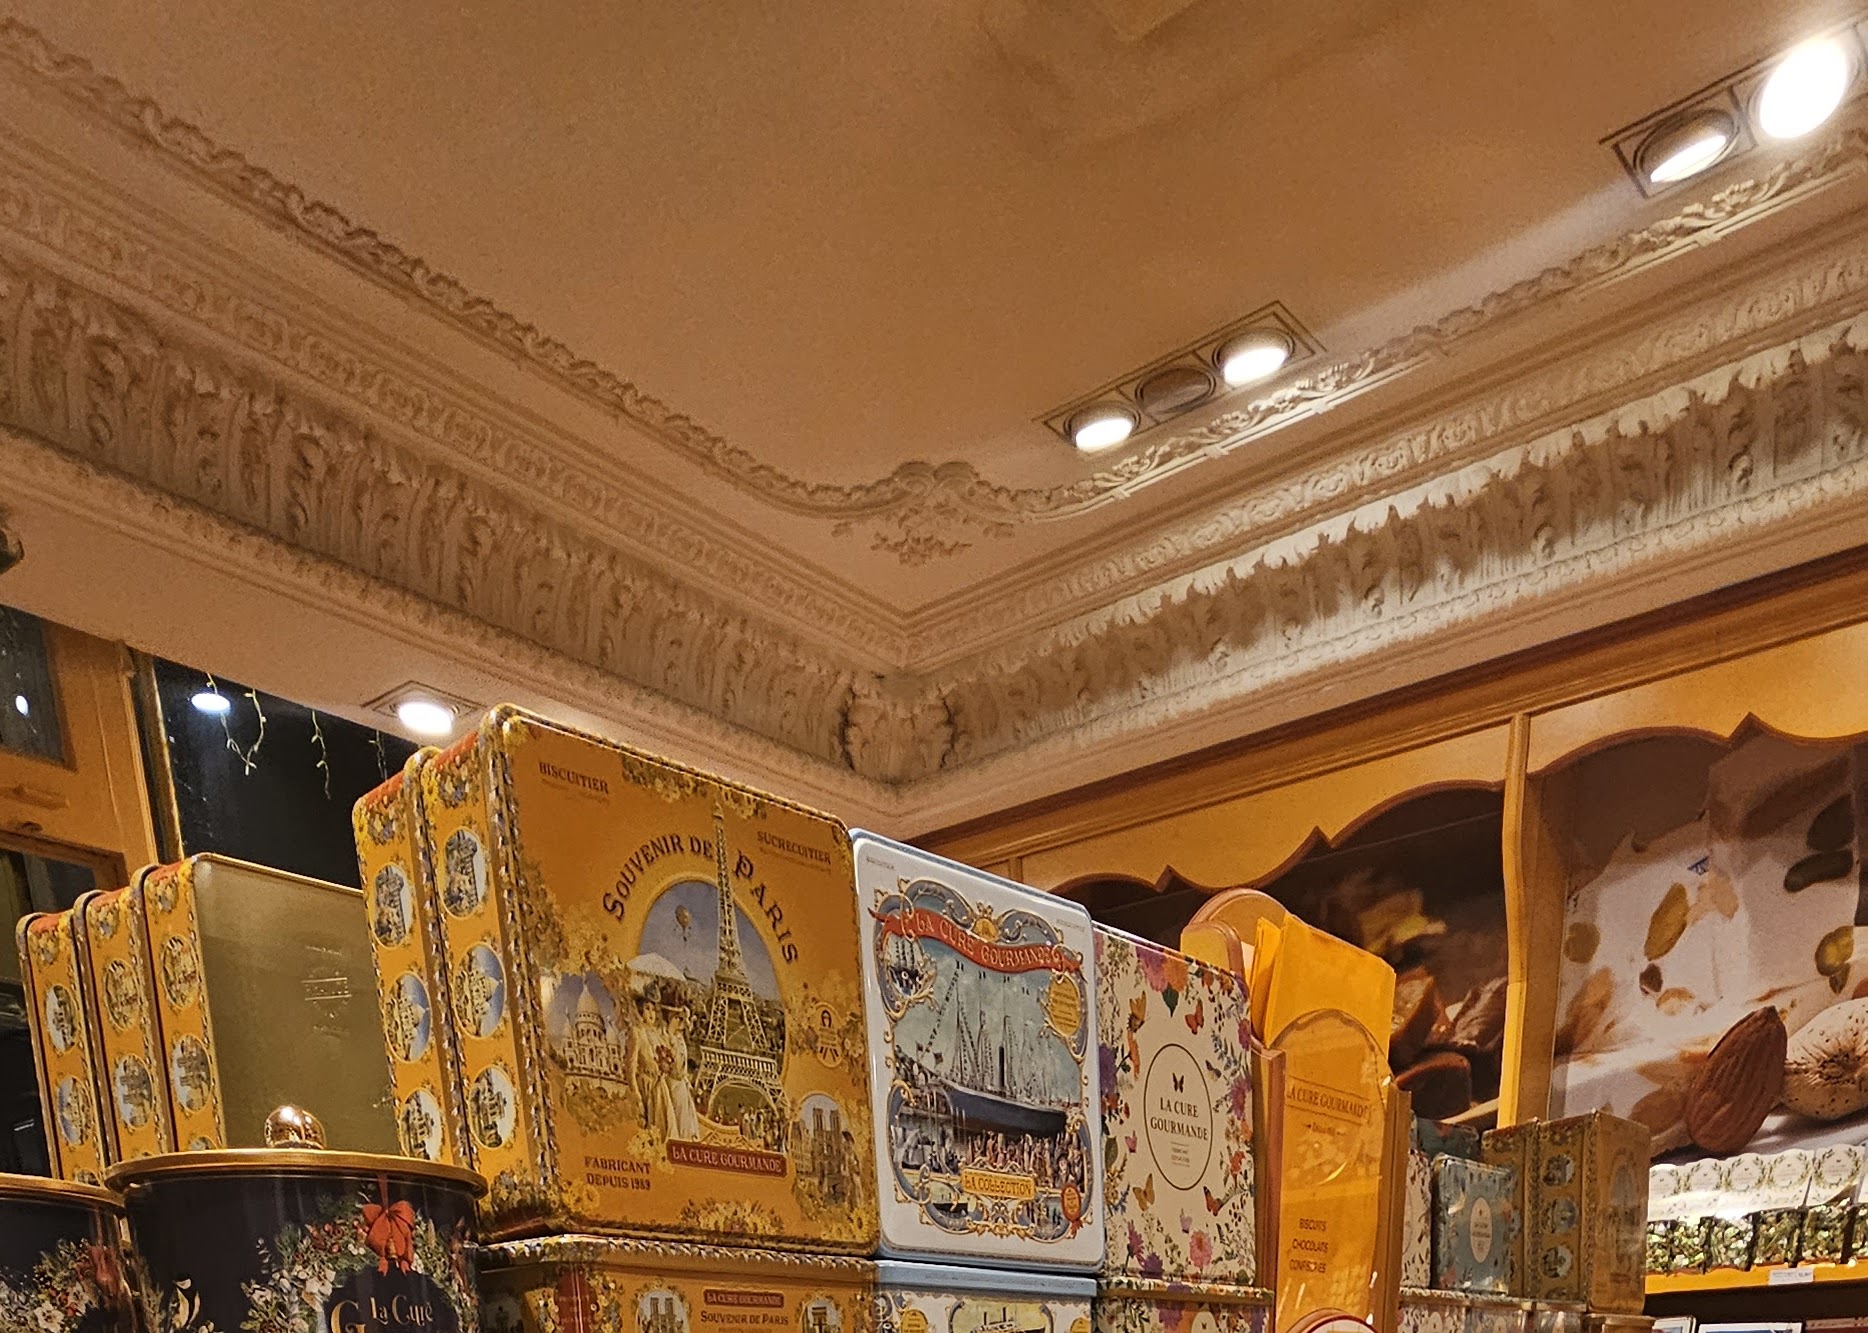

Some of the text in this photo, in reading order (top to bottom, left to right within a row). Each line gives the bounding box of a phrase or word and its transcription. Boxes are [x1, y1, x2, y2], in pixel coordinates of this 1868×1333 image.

[539, 761, 609, 794] BISCUITIER
[603, 832, 799, 965] SOUVENIR DE PARIS
[916, 914, 934, 934] LA
[938, 918, 974, 956] CURE
[1298, 1087, 1319, 1106] CURE
[1160, 1097, 1199, 1118] LA CURE
[1150, 1116, 1208, 1141] GOURMANDE
[584, 1156, 651, 1175] FABRICANT
[672, 1146, 783, 1173] LA CURE GOURMANDE
[586, 1173, 651, 1191] DEPUIS 1989
[964, 1175, 1032, 1196] LA COLLECTION
[1292, 1238, 1329, 1254] CHOCOLATS
[369, 1297, 389, 1326] La
[700, 1310, 748, 1325] SOUVENIR
[762, 1312, 789, 1326] PARIS
